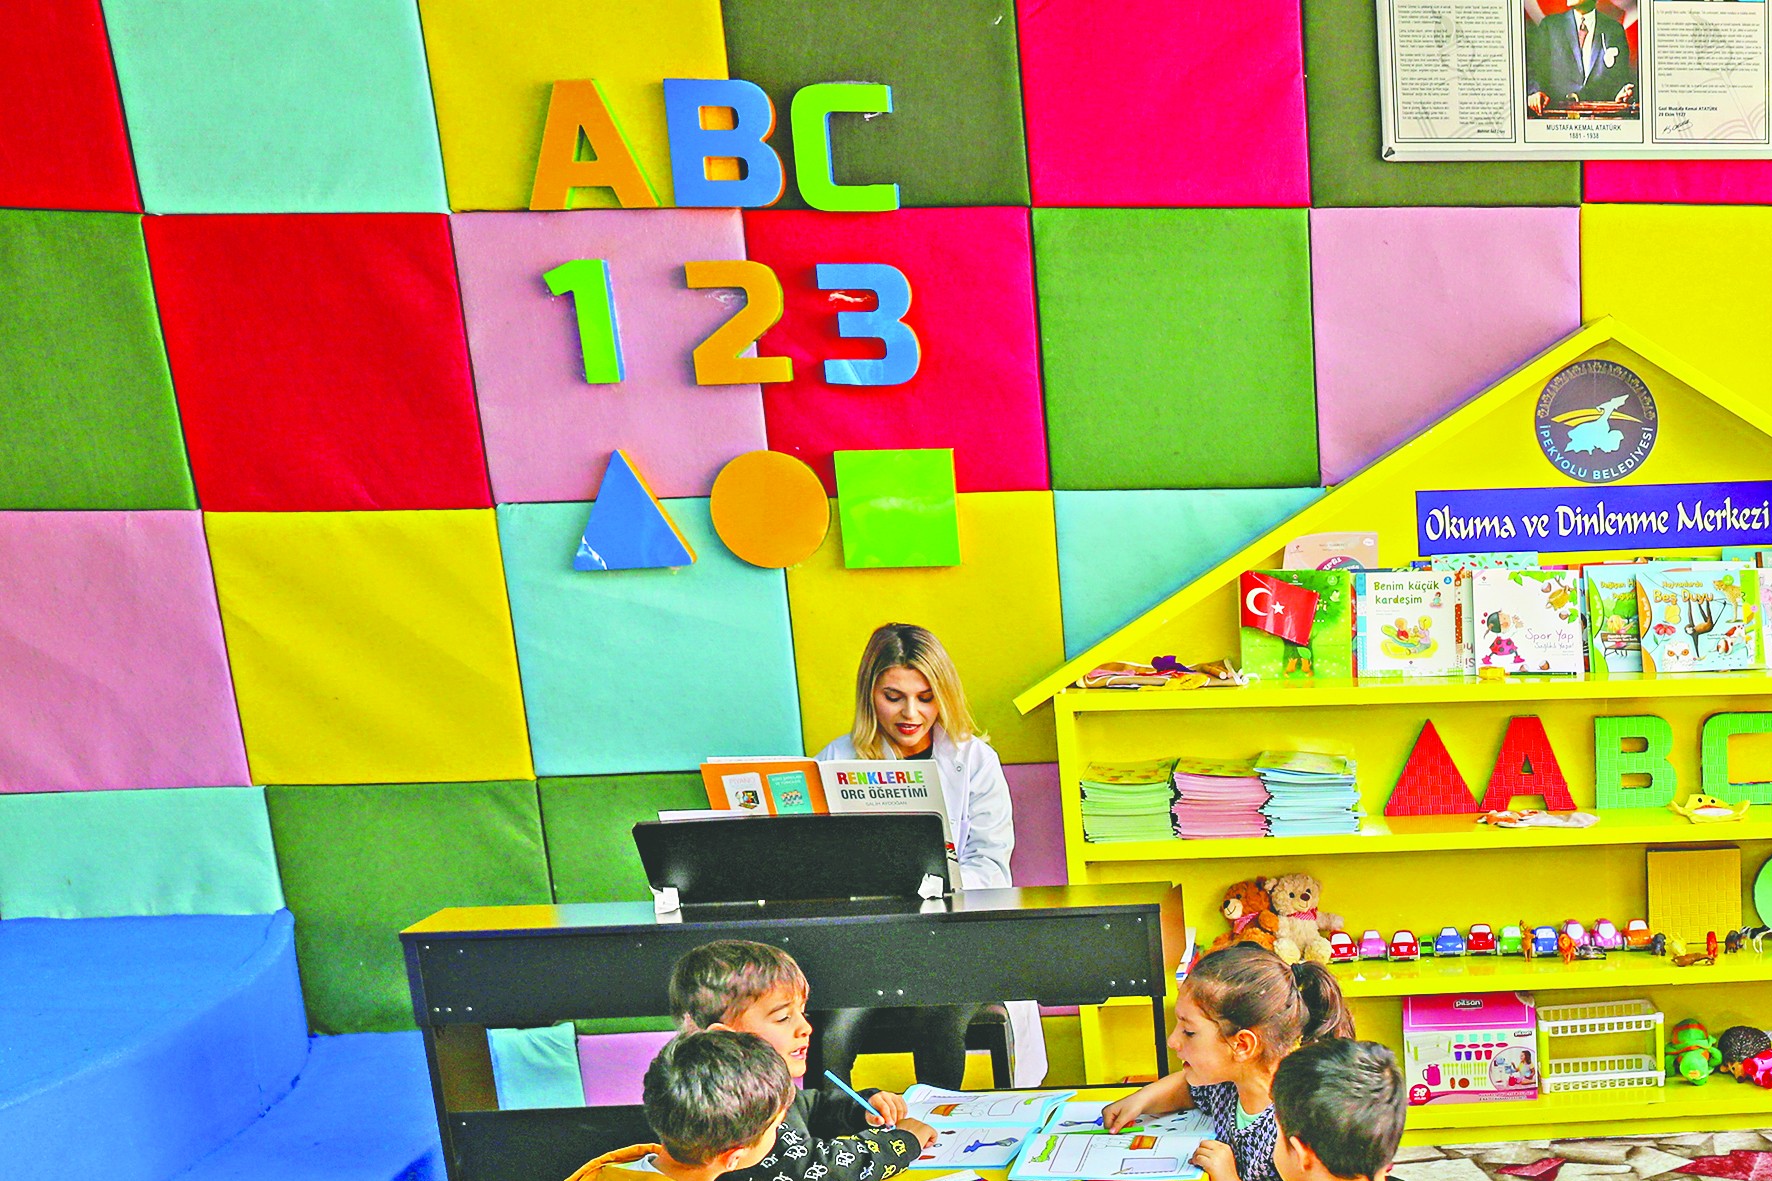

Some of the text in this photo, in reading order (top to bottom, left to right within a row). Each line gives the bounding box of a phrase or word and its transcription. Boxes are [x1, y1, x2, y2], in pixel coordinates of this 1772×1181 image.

[1546, 124, 1574, 132] MUSTAFA
[1540, 425, 1654, 480] İPEKYOLU BELEDİYESİ
[1425, 496, 1770, 541] Okuma ve Dinlenme Merkezi
[1374, 580, 1440, 592] Benim küçük
[1375, 594, 1423, 606] kardeşim
[1653, 588, 1714, 605] Beş Duyu
[1525, 628, 1574, 642] Spor Yap
[836, 771, 924, 785] RENKLERLE
[841, 785, 928, 800] ORG ÖĞRETİMİ
